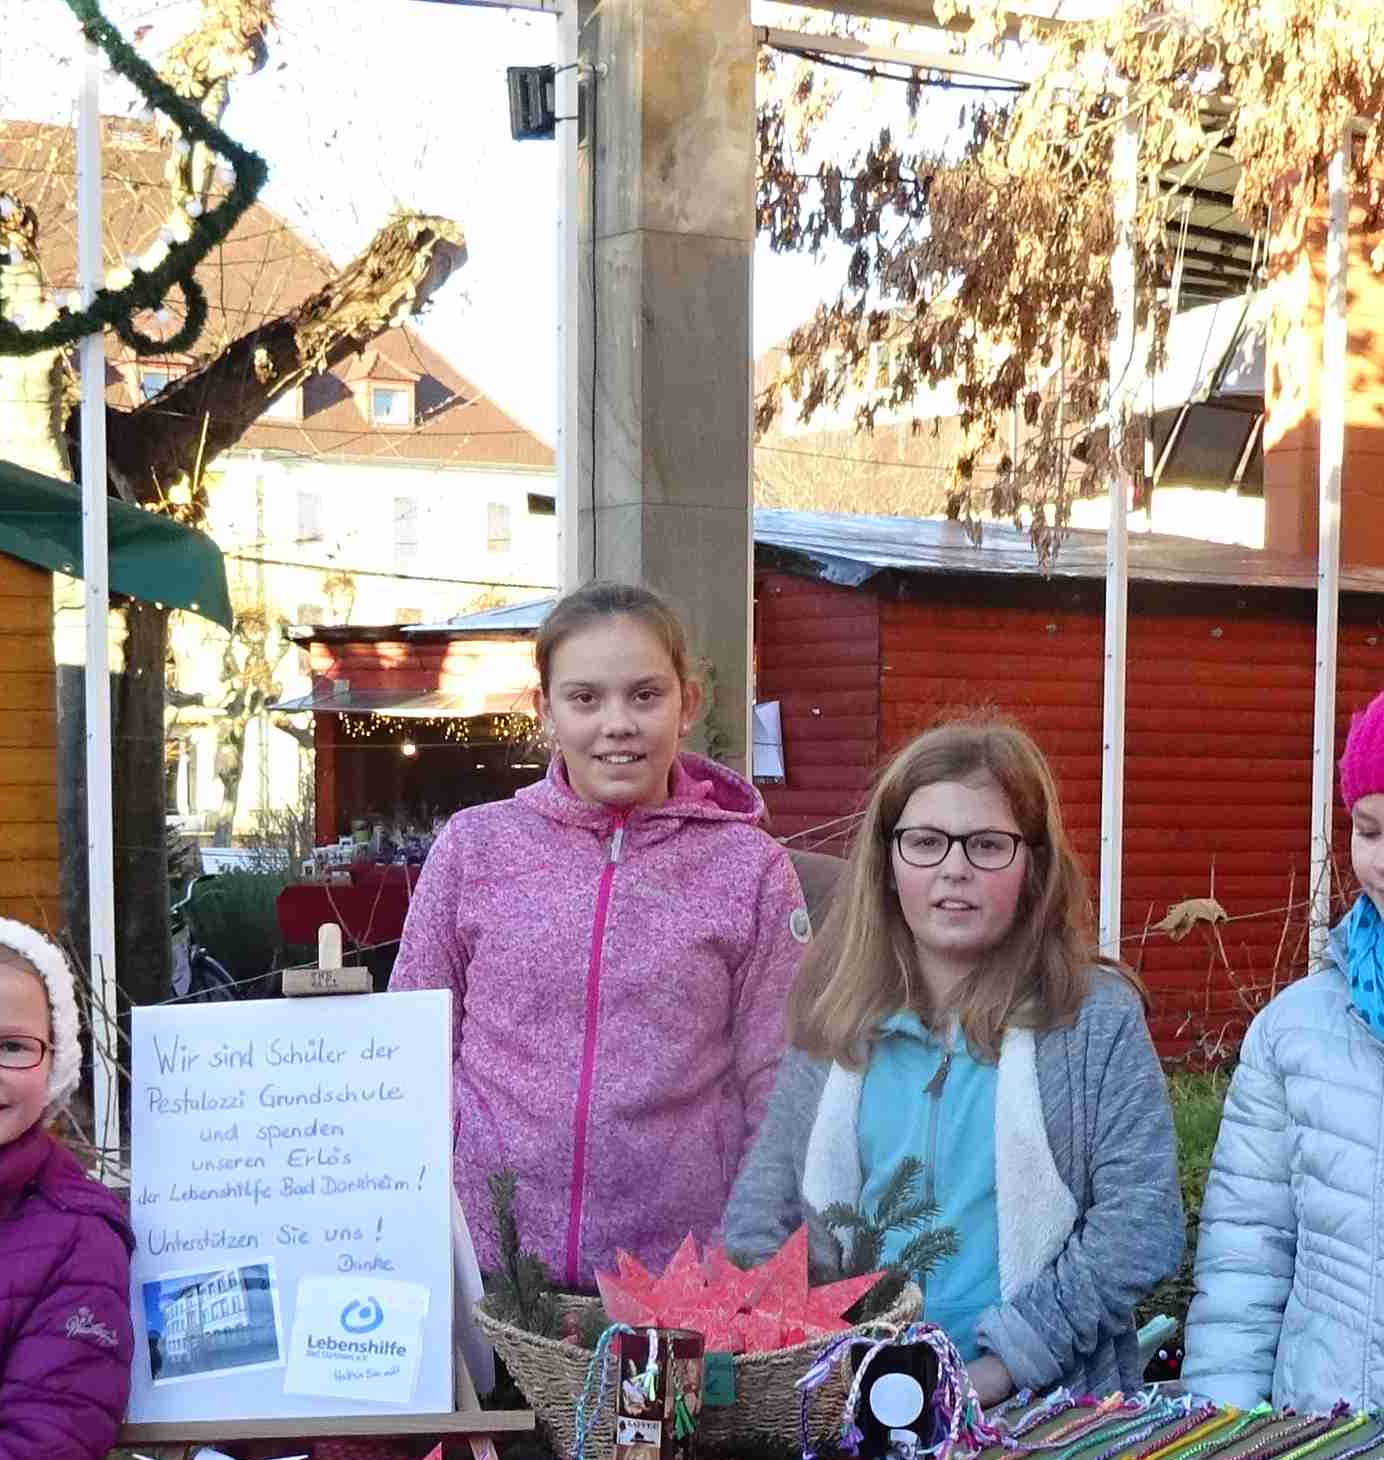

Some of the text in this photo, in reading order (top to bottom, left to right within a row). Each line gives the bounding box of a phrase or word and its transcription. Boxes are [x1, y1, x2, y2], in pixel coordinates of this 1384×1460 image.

[152, 1033, 401, 1075] Wir sind Schüler der
[145, 1081, 406, 1115] Pestalozzi Grundschule
[199, 1118, 346, 1149] und spenden
[190, 1147, 353, 1172] unseren Erlös
[137, 1186, 161, 1206] der
[168, 1180, 272, 1206] Lebenshilfe
[279, 1177, 316, 1197] Bad
[147, 1229, 260, 1256] Unterstützen
[276, 1223, 313, 1246] Sie
[306, 1334, 408, 1358] Lebenshilfe
